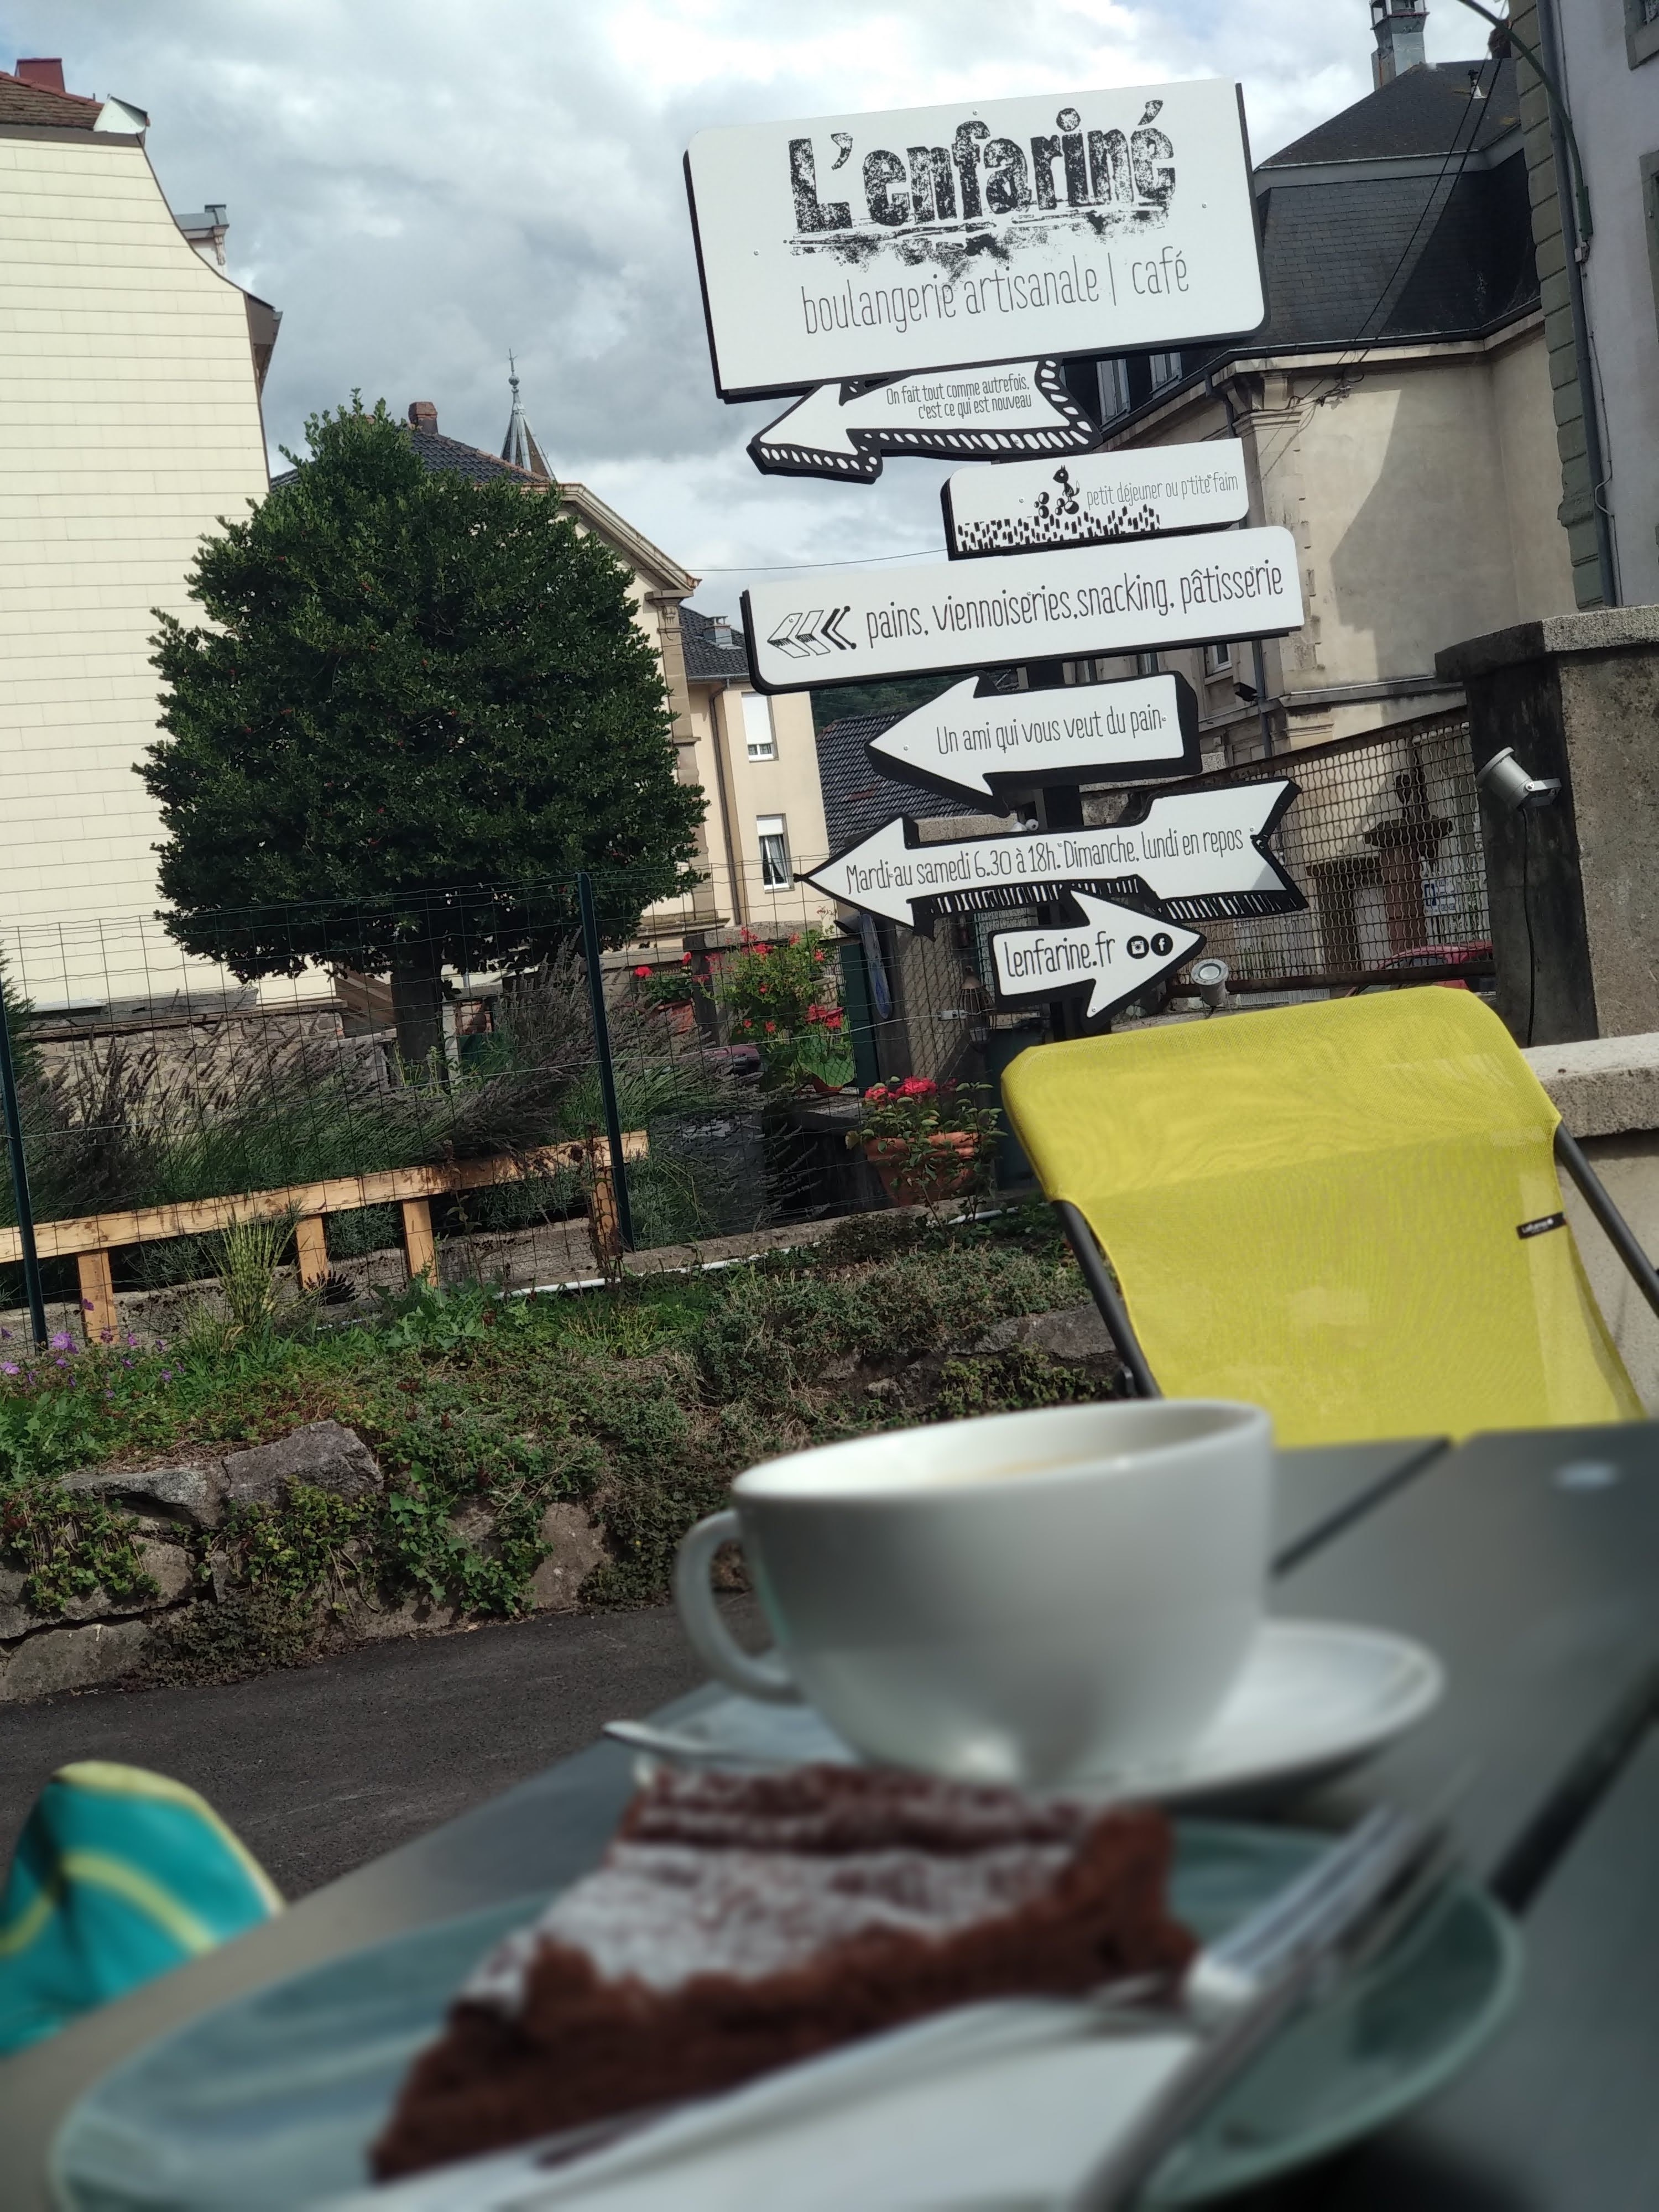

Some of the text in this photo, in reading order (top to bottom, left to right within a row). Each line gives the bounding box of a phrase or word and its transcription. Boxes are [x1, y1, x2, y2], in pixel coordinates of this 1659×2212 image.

[789, 100, 1176, 234] L'enfariné
[801, 274, 956, 334] boulangerie
[964, 255, 1099, 315] artisanale
[1131, 246, 1190, 295] café
[886, 373, 1030, 405] On fait tout comme autrefois.
[919, 393, 1032, 419] c'est ce qui est nouveau
[1087, 472, 1238, 510] petit déjeuner ou p'tite faim
[1180, 559, 1284, 614] pâtisserie
[936, 726, 959, 754] Un
[963, 722, 992, 751] ami
[995, 719, 1019, 753] qui
[1021, 717, 1061, 743] vous
[1063, 710, 1104, 739] veut
[1107, 706, 1126, 735] du
[846, 859, 891, 895] Mardi
[894, 864, 913, 887] au
[916, 851, 972, 885] samedi
[974, 850, 1012, 878] 6.30
[1016, 848, 1027, 873] à
[1141, 828, 1179, 860] lundi
[1182, 831, 1200, 856] en
[1203, 829, 1244, 858] repos
[1004, 931, 1116, 977] lenfarine.fr
